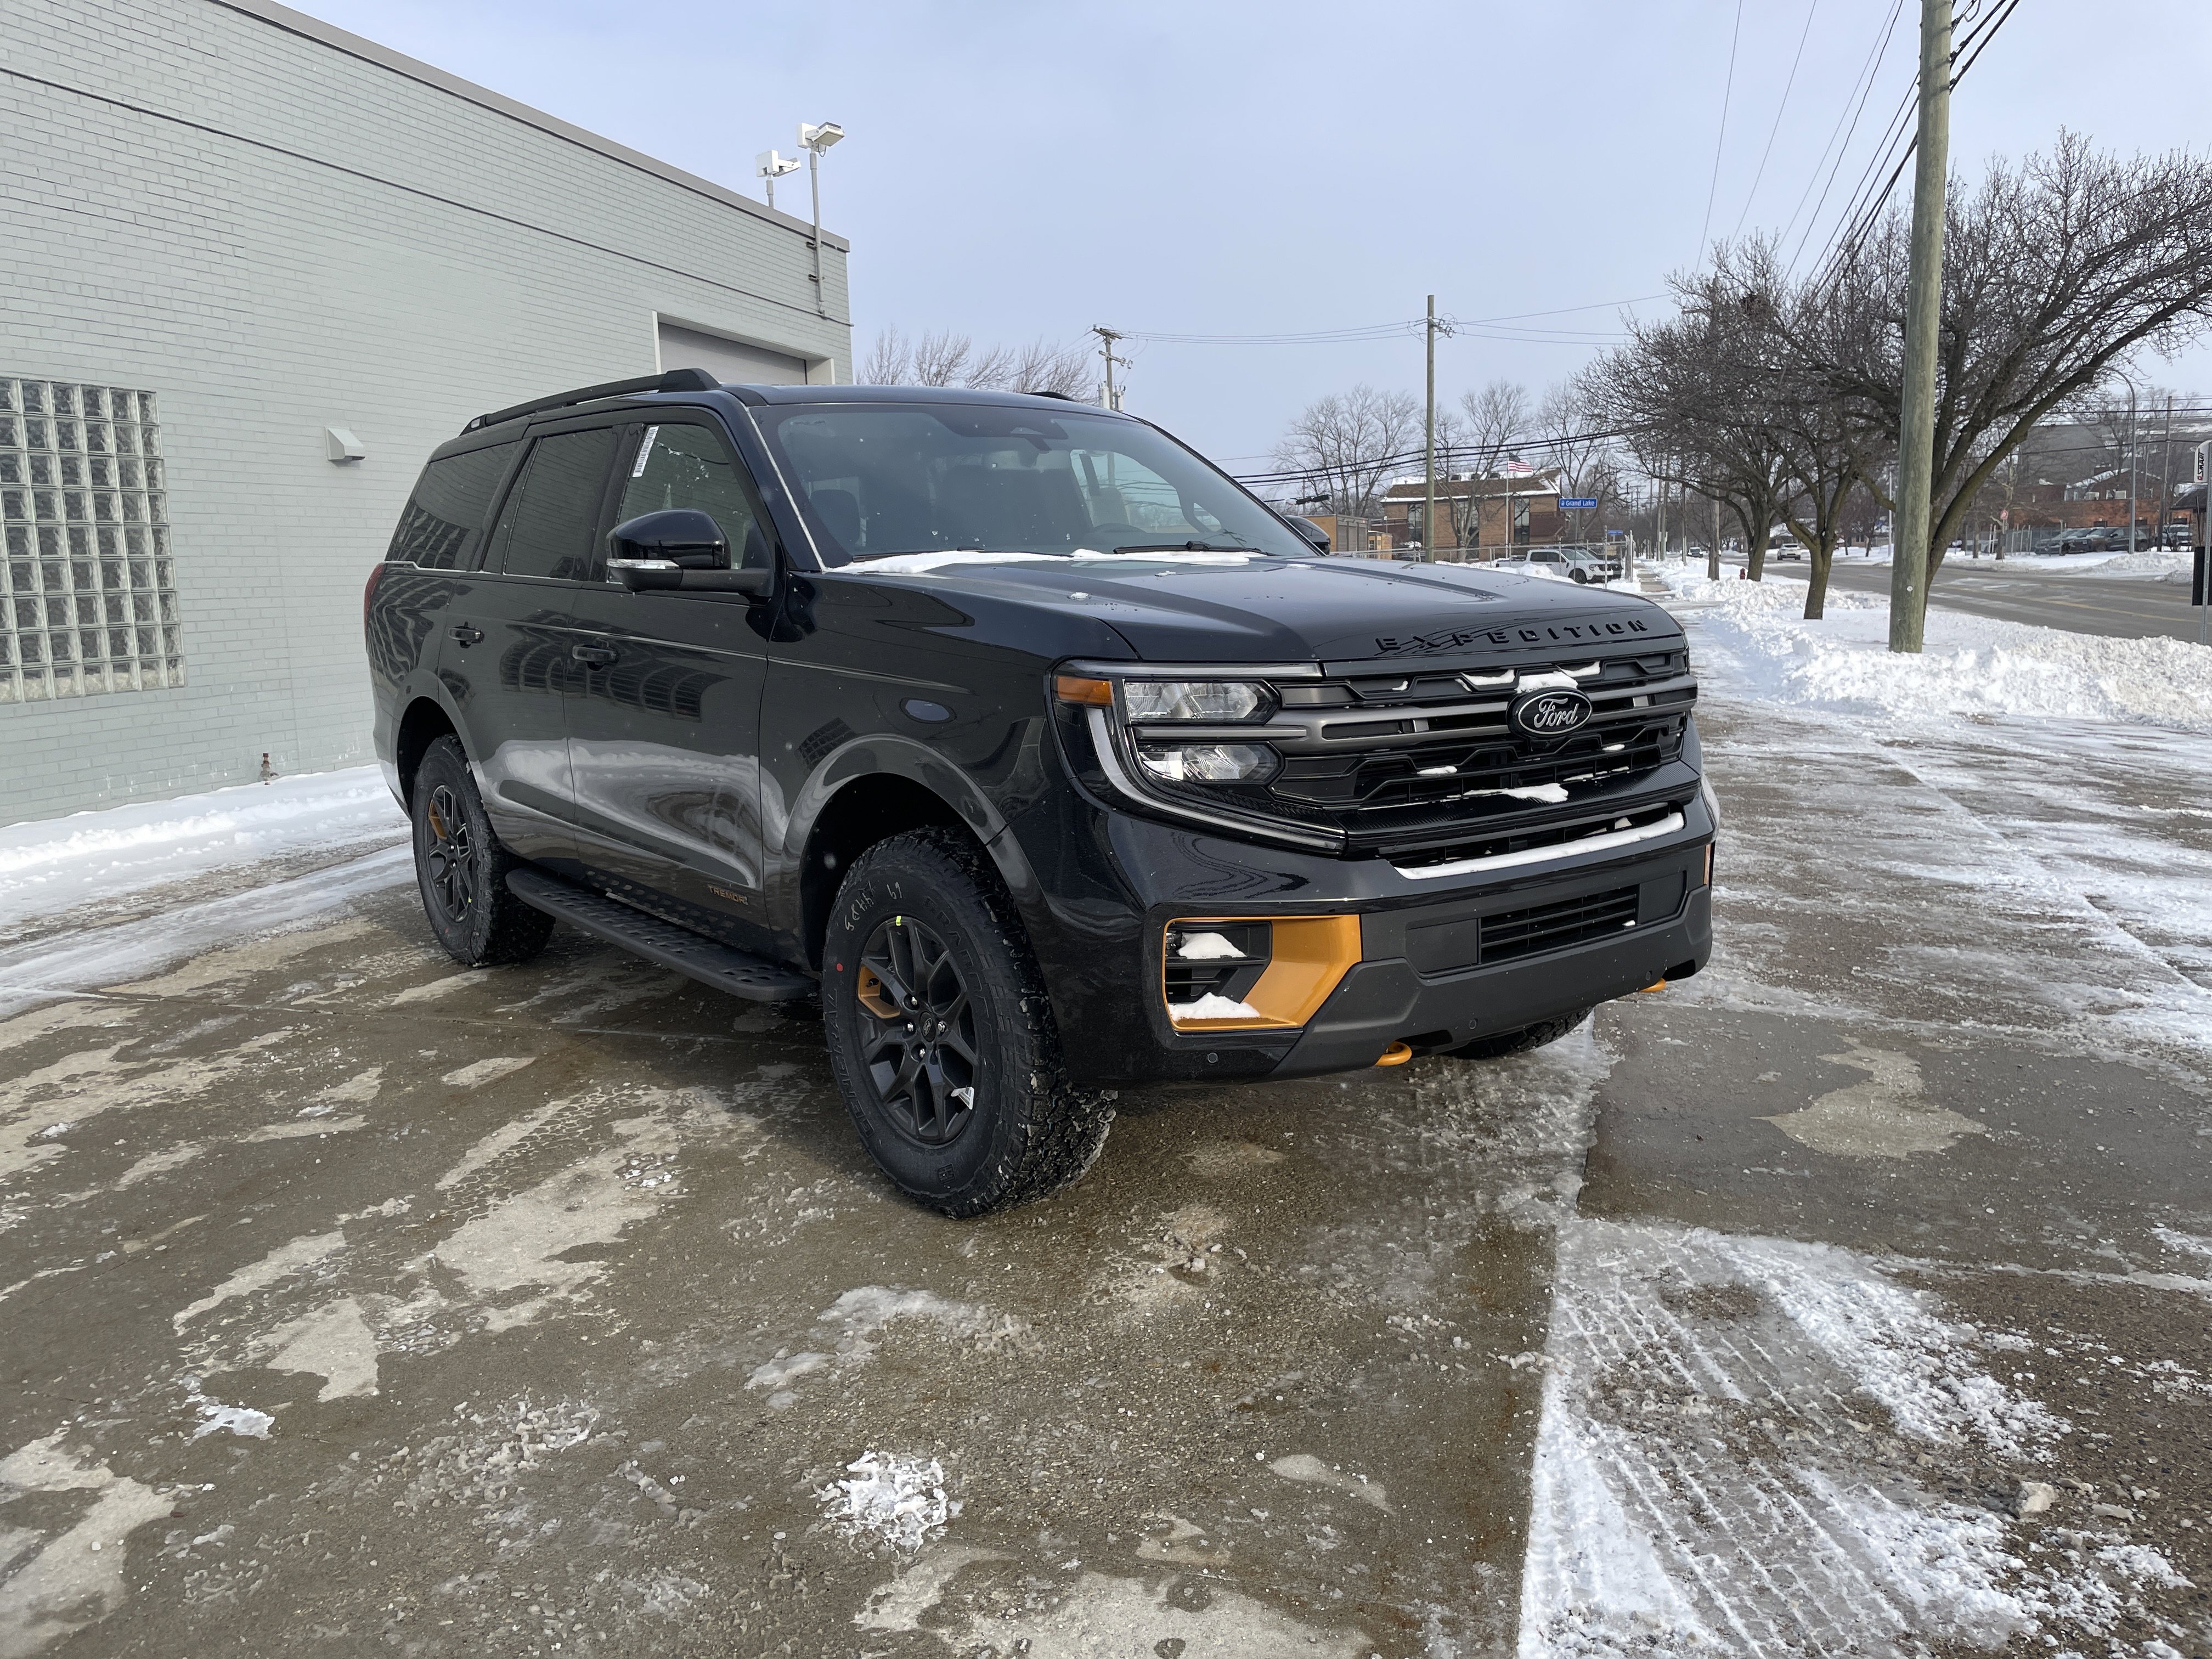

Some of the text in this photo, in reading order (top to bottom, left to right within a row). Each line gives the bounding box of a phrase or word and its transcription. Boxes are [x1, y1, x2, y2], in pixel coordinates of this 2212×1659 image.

[1375, 619, 1649, 651] EXPEDITION
[1533, 697, 1579, 729] Ford
[708, 885, 749, 906] TREMOR
